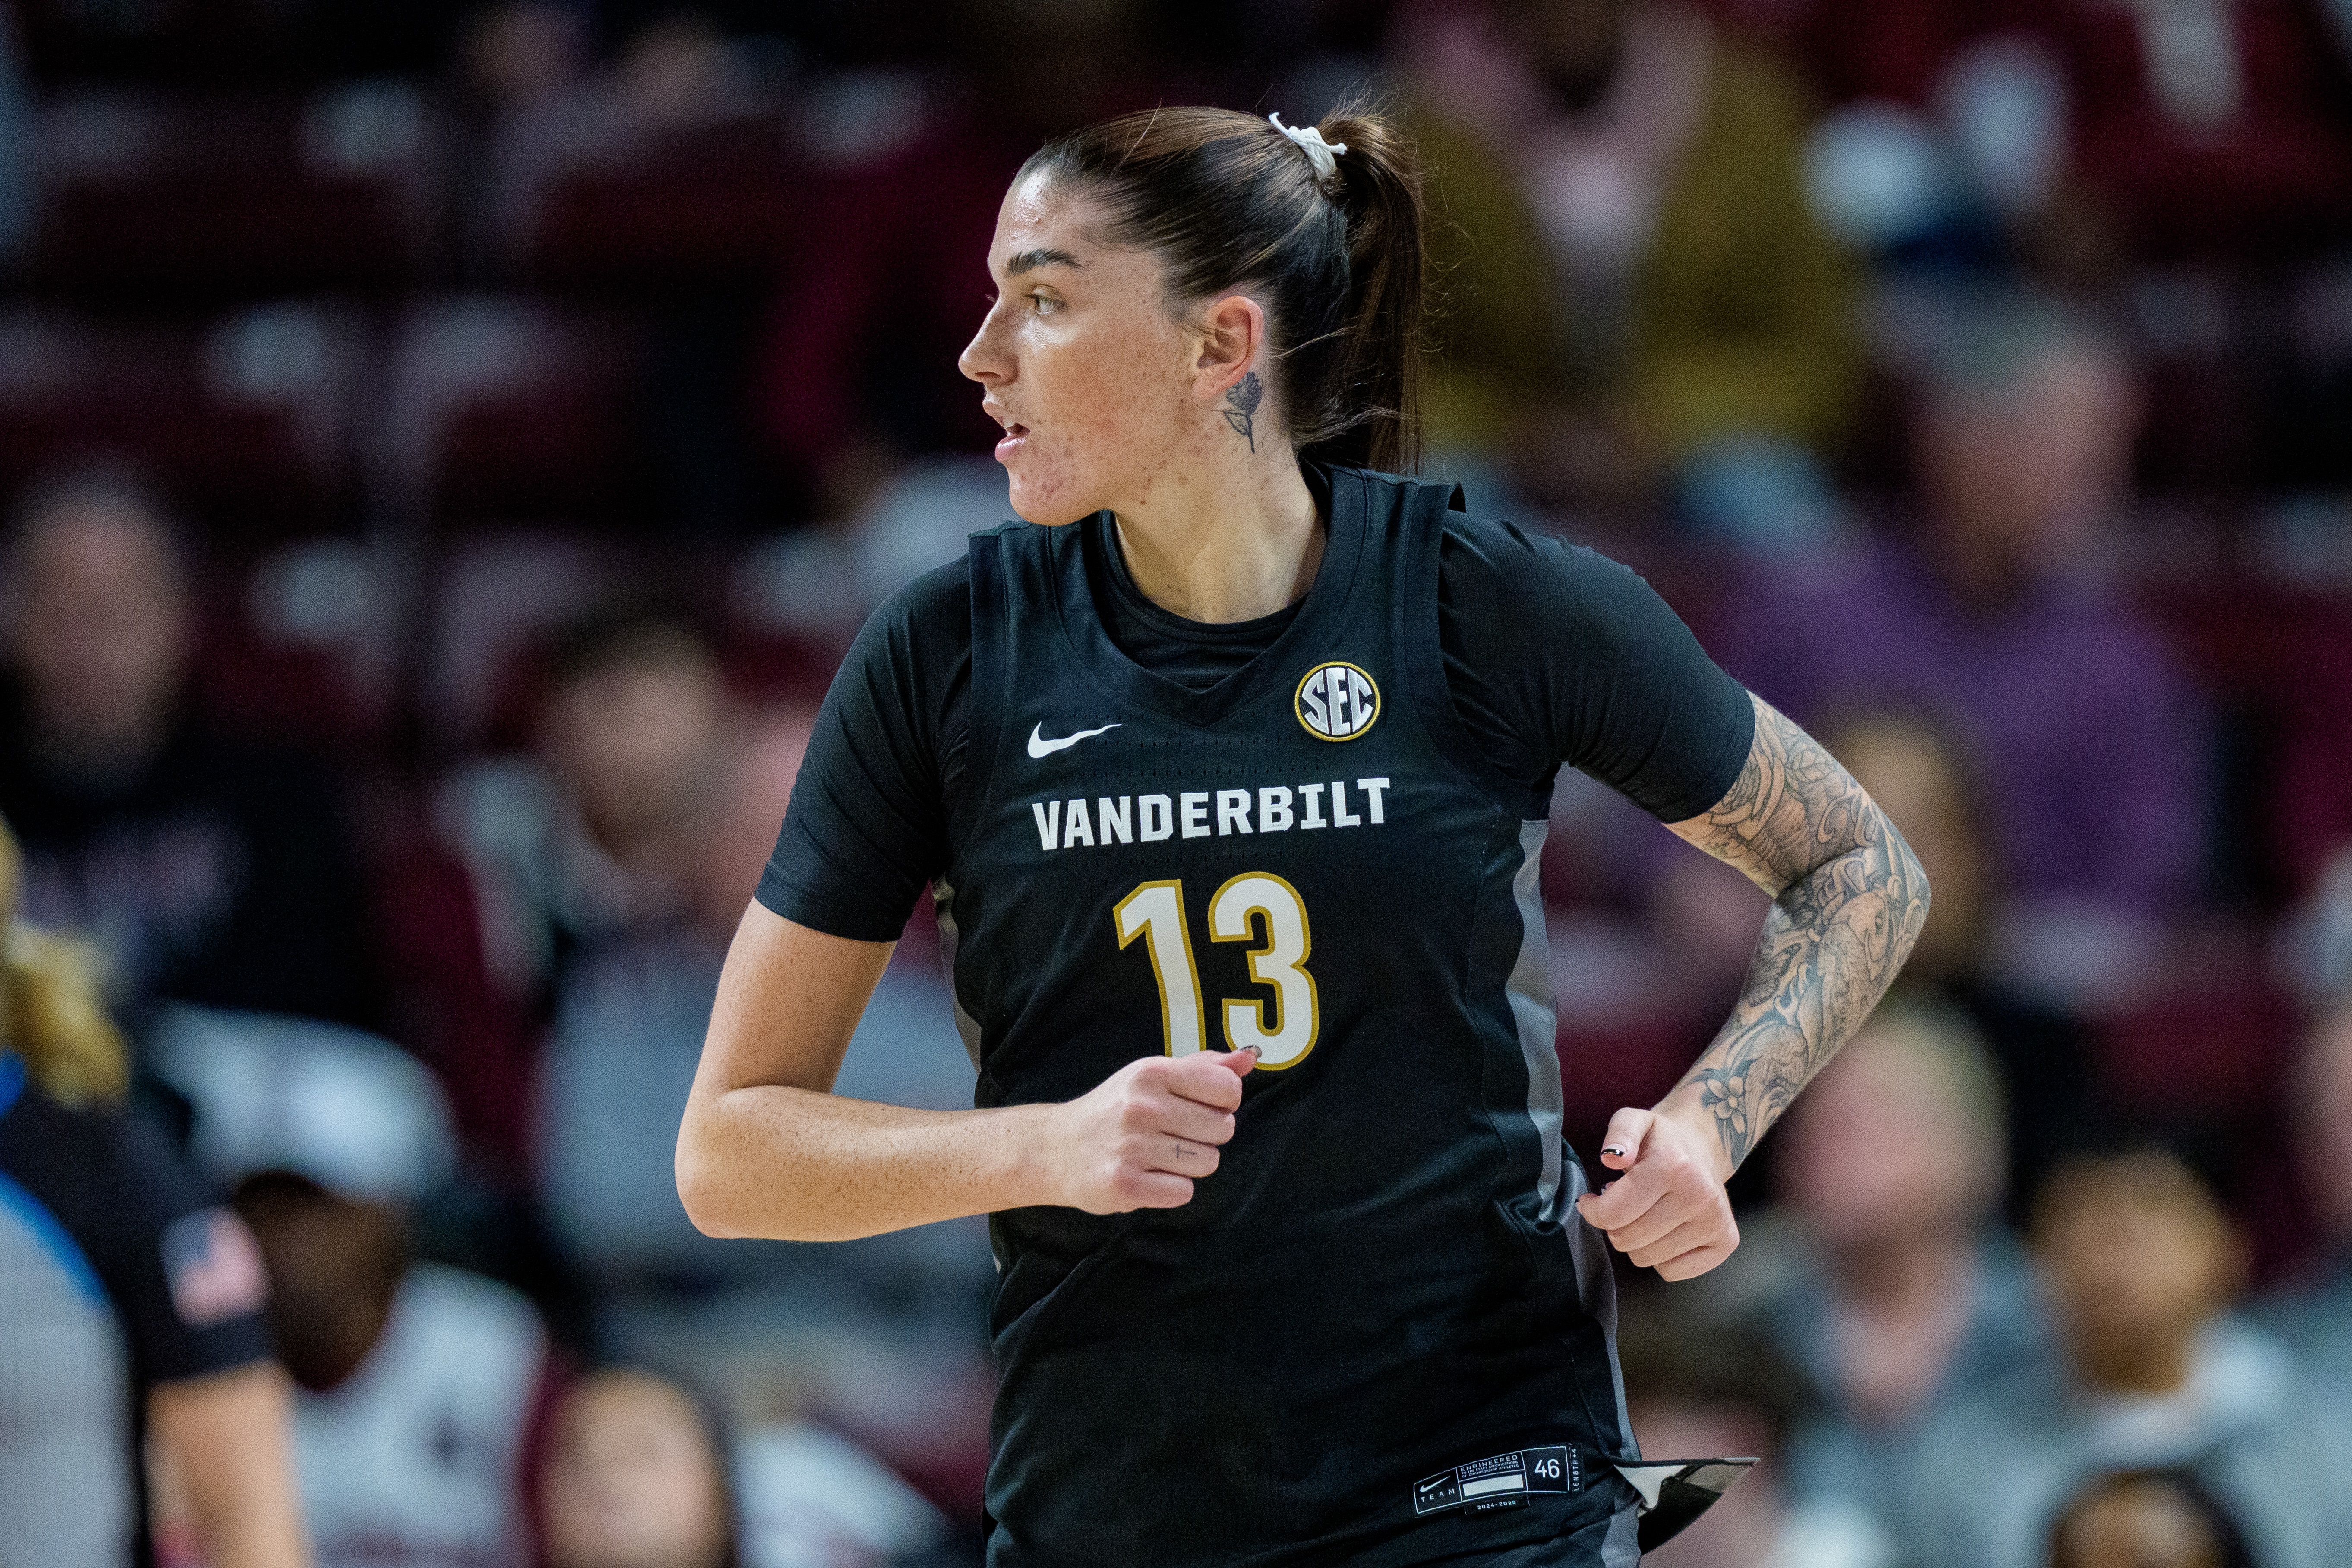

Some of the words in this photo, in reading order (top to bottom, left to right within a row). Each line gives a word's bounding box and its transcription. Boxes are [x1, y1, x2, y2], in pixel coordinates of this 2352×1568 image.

[1302, 667, 1373, 735] SEC
[1032, 777, 1390, 851] VANDERBILT
[1113, 871, 1319, 1071] 13
[1460, 1454, 1518, 1472] ENGINEERED
[1468, 1467, 1498, 1476] CHAMPIONSHIP
[1488, 1460, 1519, 1469] SPECIFICATIONS
[1534, 1458, 1560, 1479] 46
[1420, 1488, 1455, 1502] TEAM
[1477, 1500, 1516, 1509] 2024-2025
